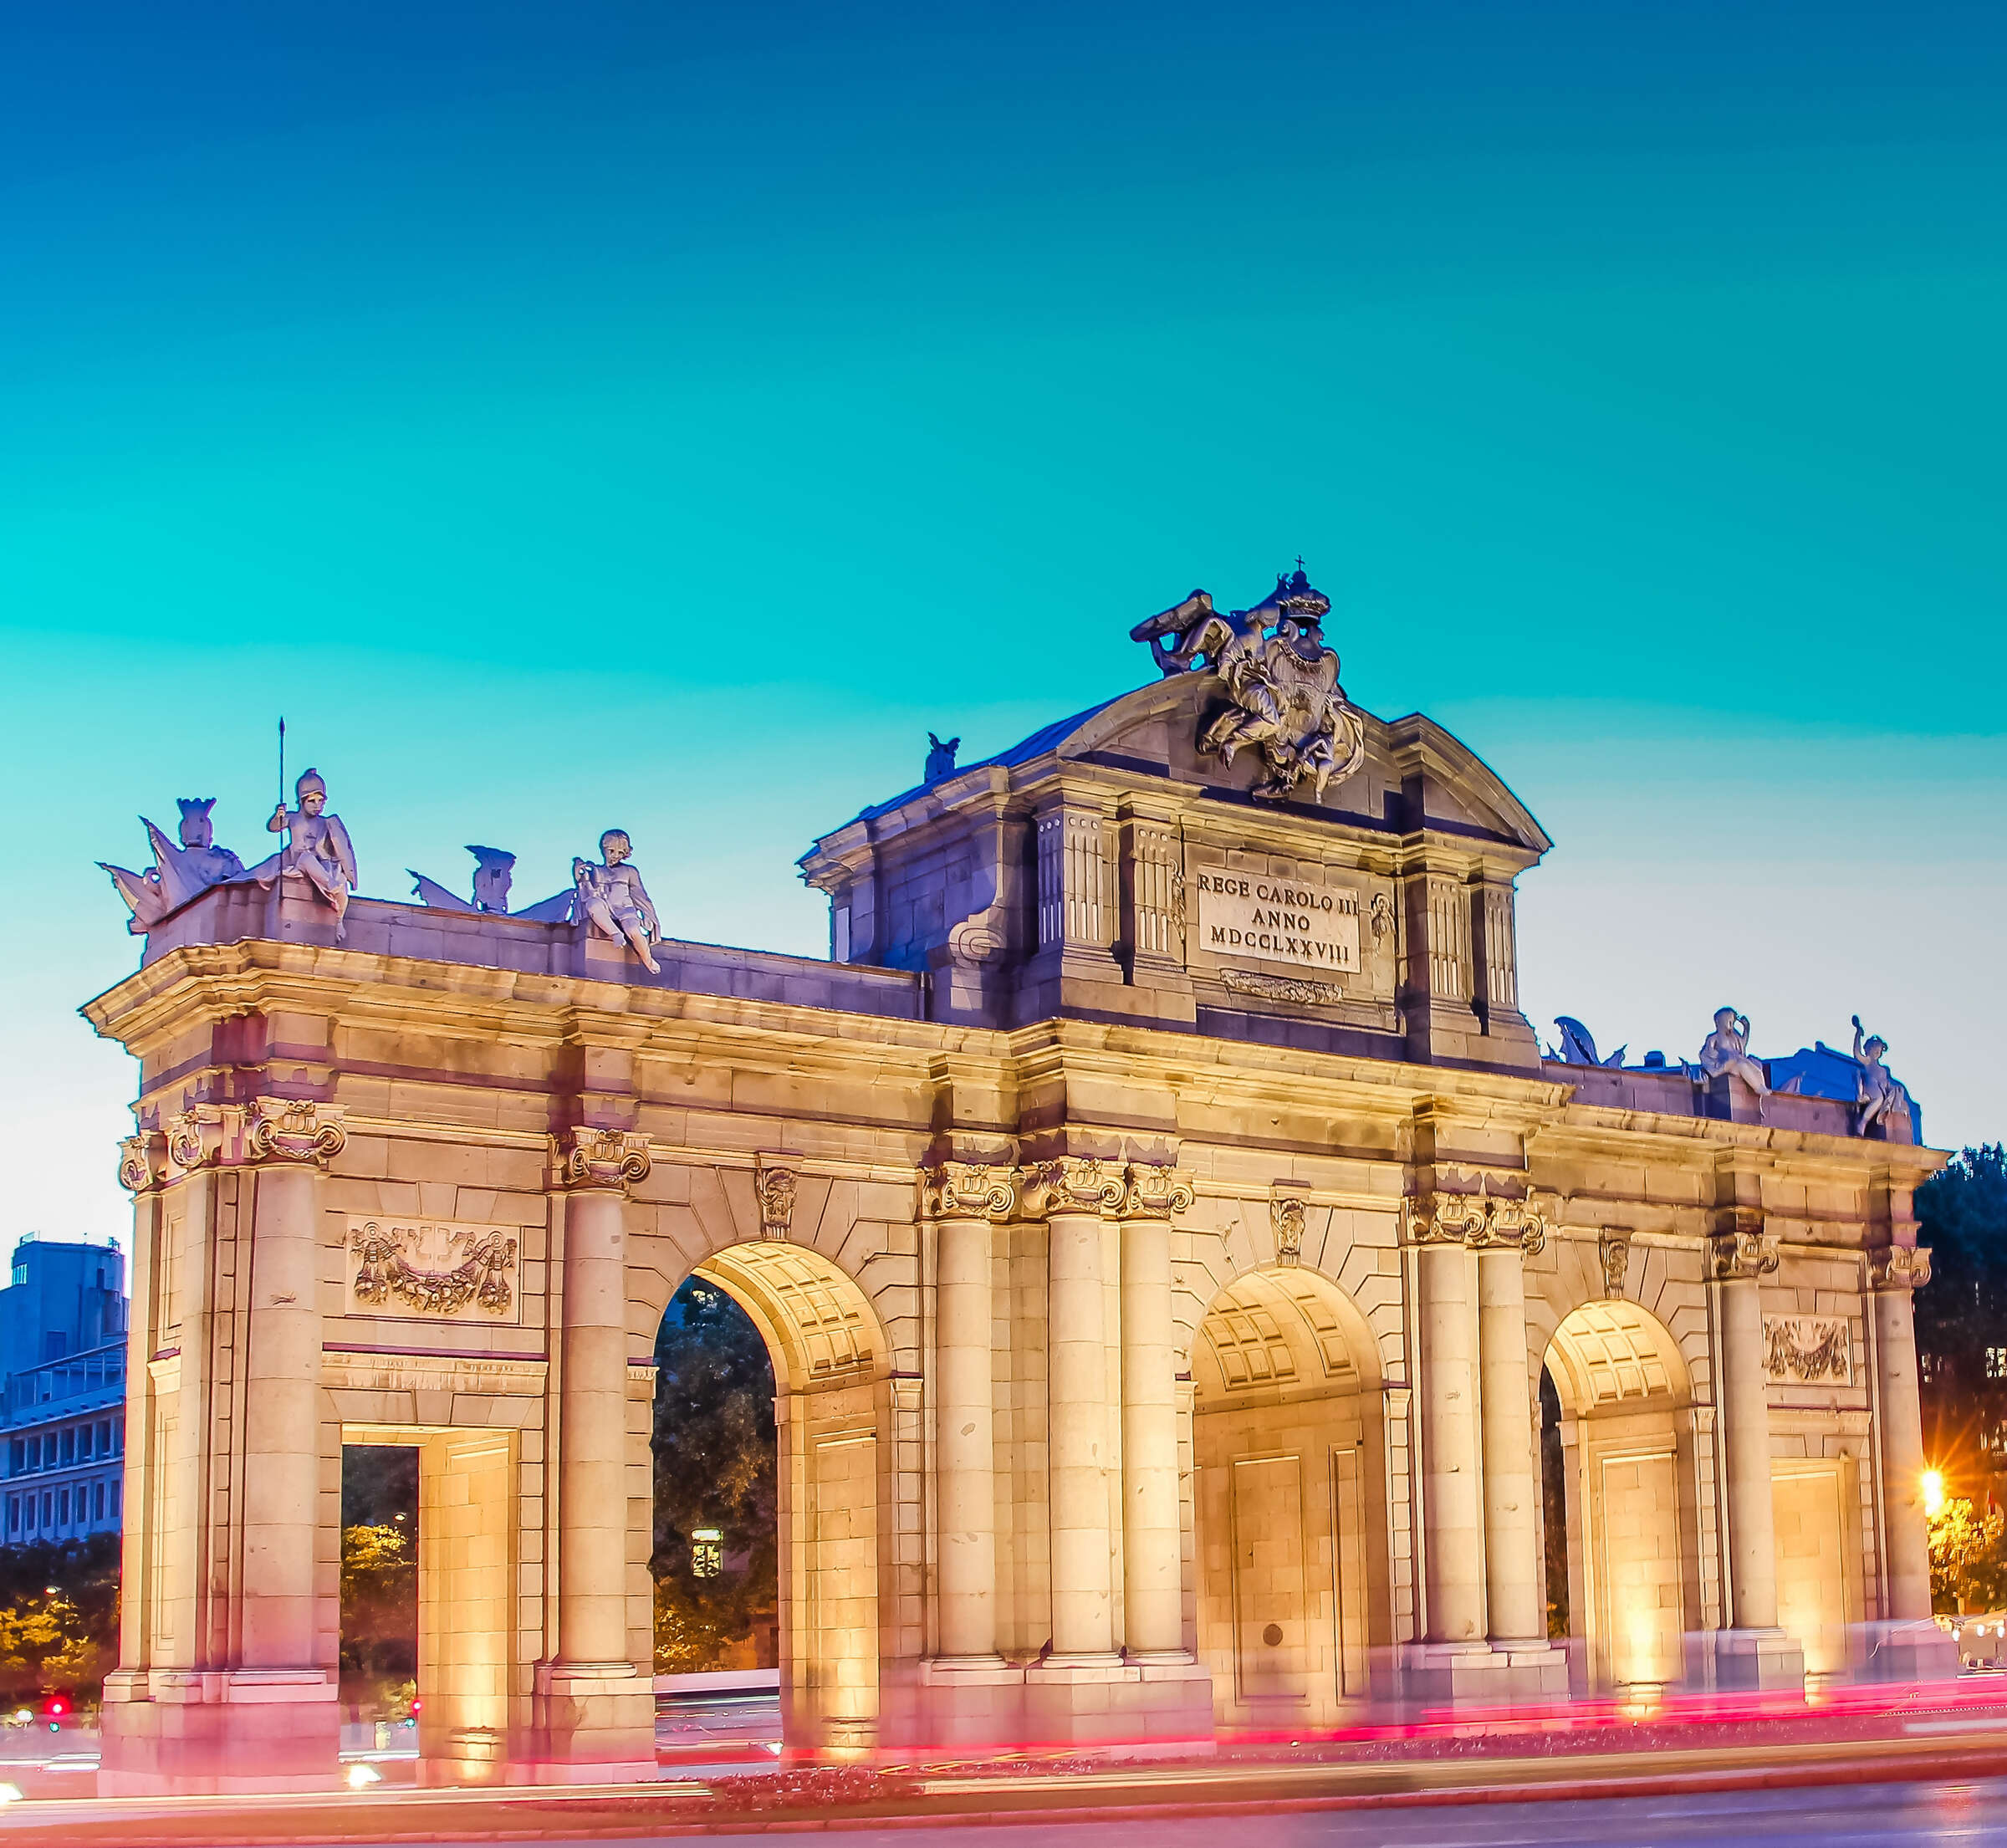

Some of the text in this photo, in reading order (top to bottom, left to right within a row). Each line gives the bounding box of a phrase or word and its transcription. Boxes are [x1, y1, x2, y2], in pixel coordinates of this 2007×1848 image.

[1198, 873, 1359, 916] REGE CAROLO III
[1251, 907, 1310, 931] ANNO
[1211, 925, 1349, 963] MDCCLXXVIII
